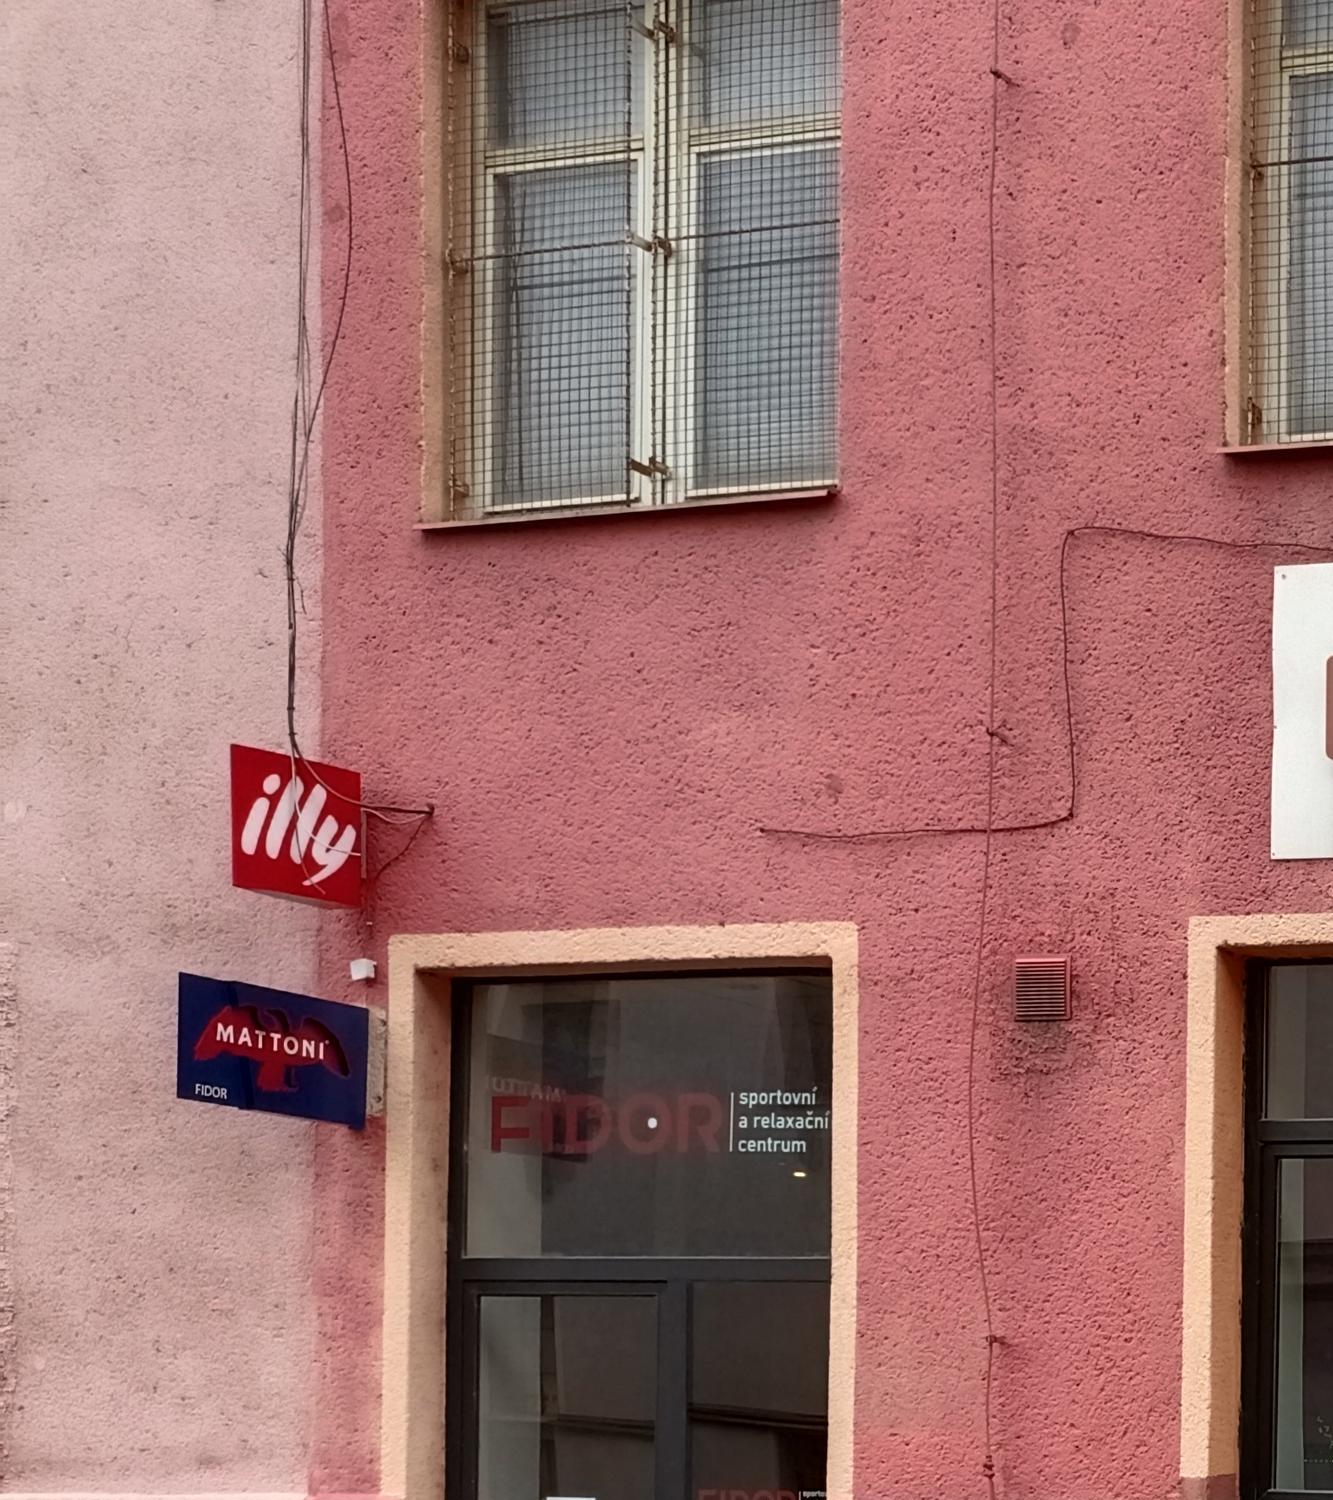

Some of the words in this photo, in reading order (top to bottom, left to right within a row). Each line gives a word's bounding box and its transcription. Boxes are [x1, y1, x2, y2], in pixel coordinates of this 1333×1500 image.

[240, 773, 357, 887] illy
[215, 1021, 326, 1061] MATTONI
[195, 1083, 228, 1100] FIDOR
[739, 1086, 818, 1106] sportovní
[490, 1092, 723, 1155] FIDOR
[738, 1116, 748, 1129] a
[753, 1111, 831, 1130] relaxační
[738, 1137, 807, 1152] centrum
